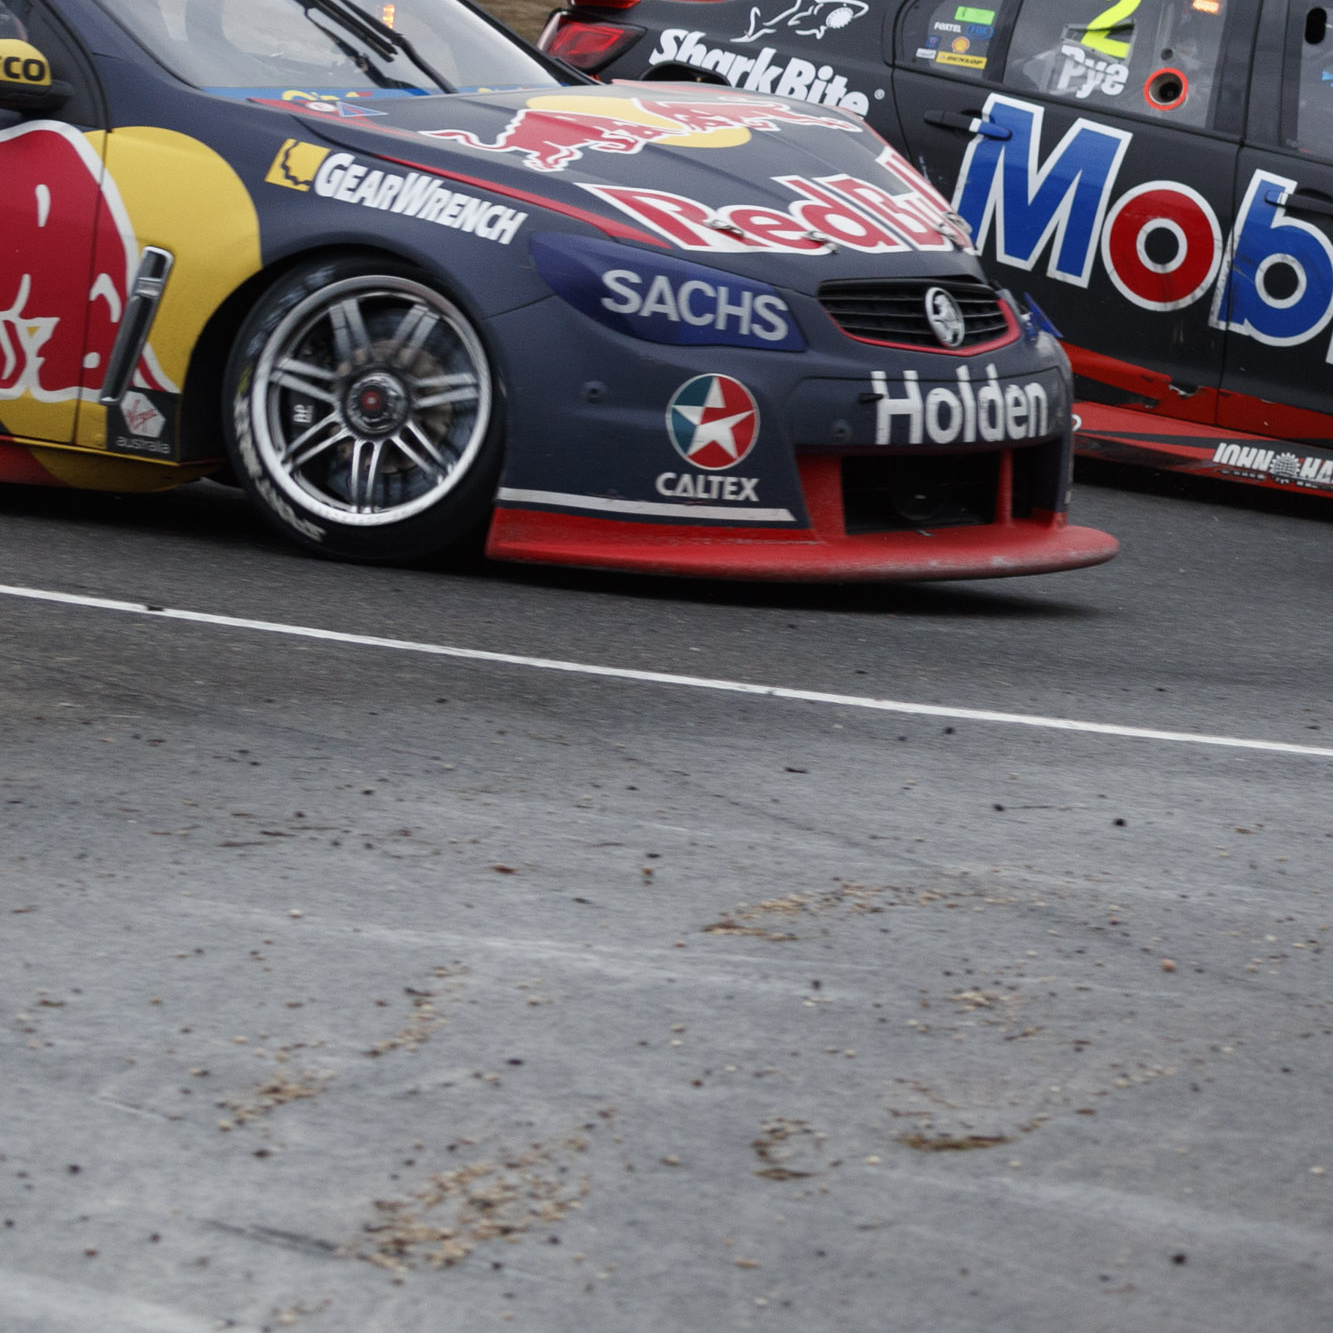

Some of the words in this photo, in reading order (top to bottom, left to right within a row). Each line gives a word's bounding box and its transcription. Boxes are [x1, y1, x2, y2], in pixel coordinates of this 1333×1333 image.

[649, 29, 870, 120] SharkBite
[1056, 45, 1130, 99] Pye
[601, 270, 789, 341] SACHS
[870, 363, 1048, 445] Holden
[655, 472, 760, 502] CALTEX
